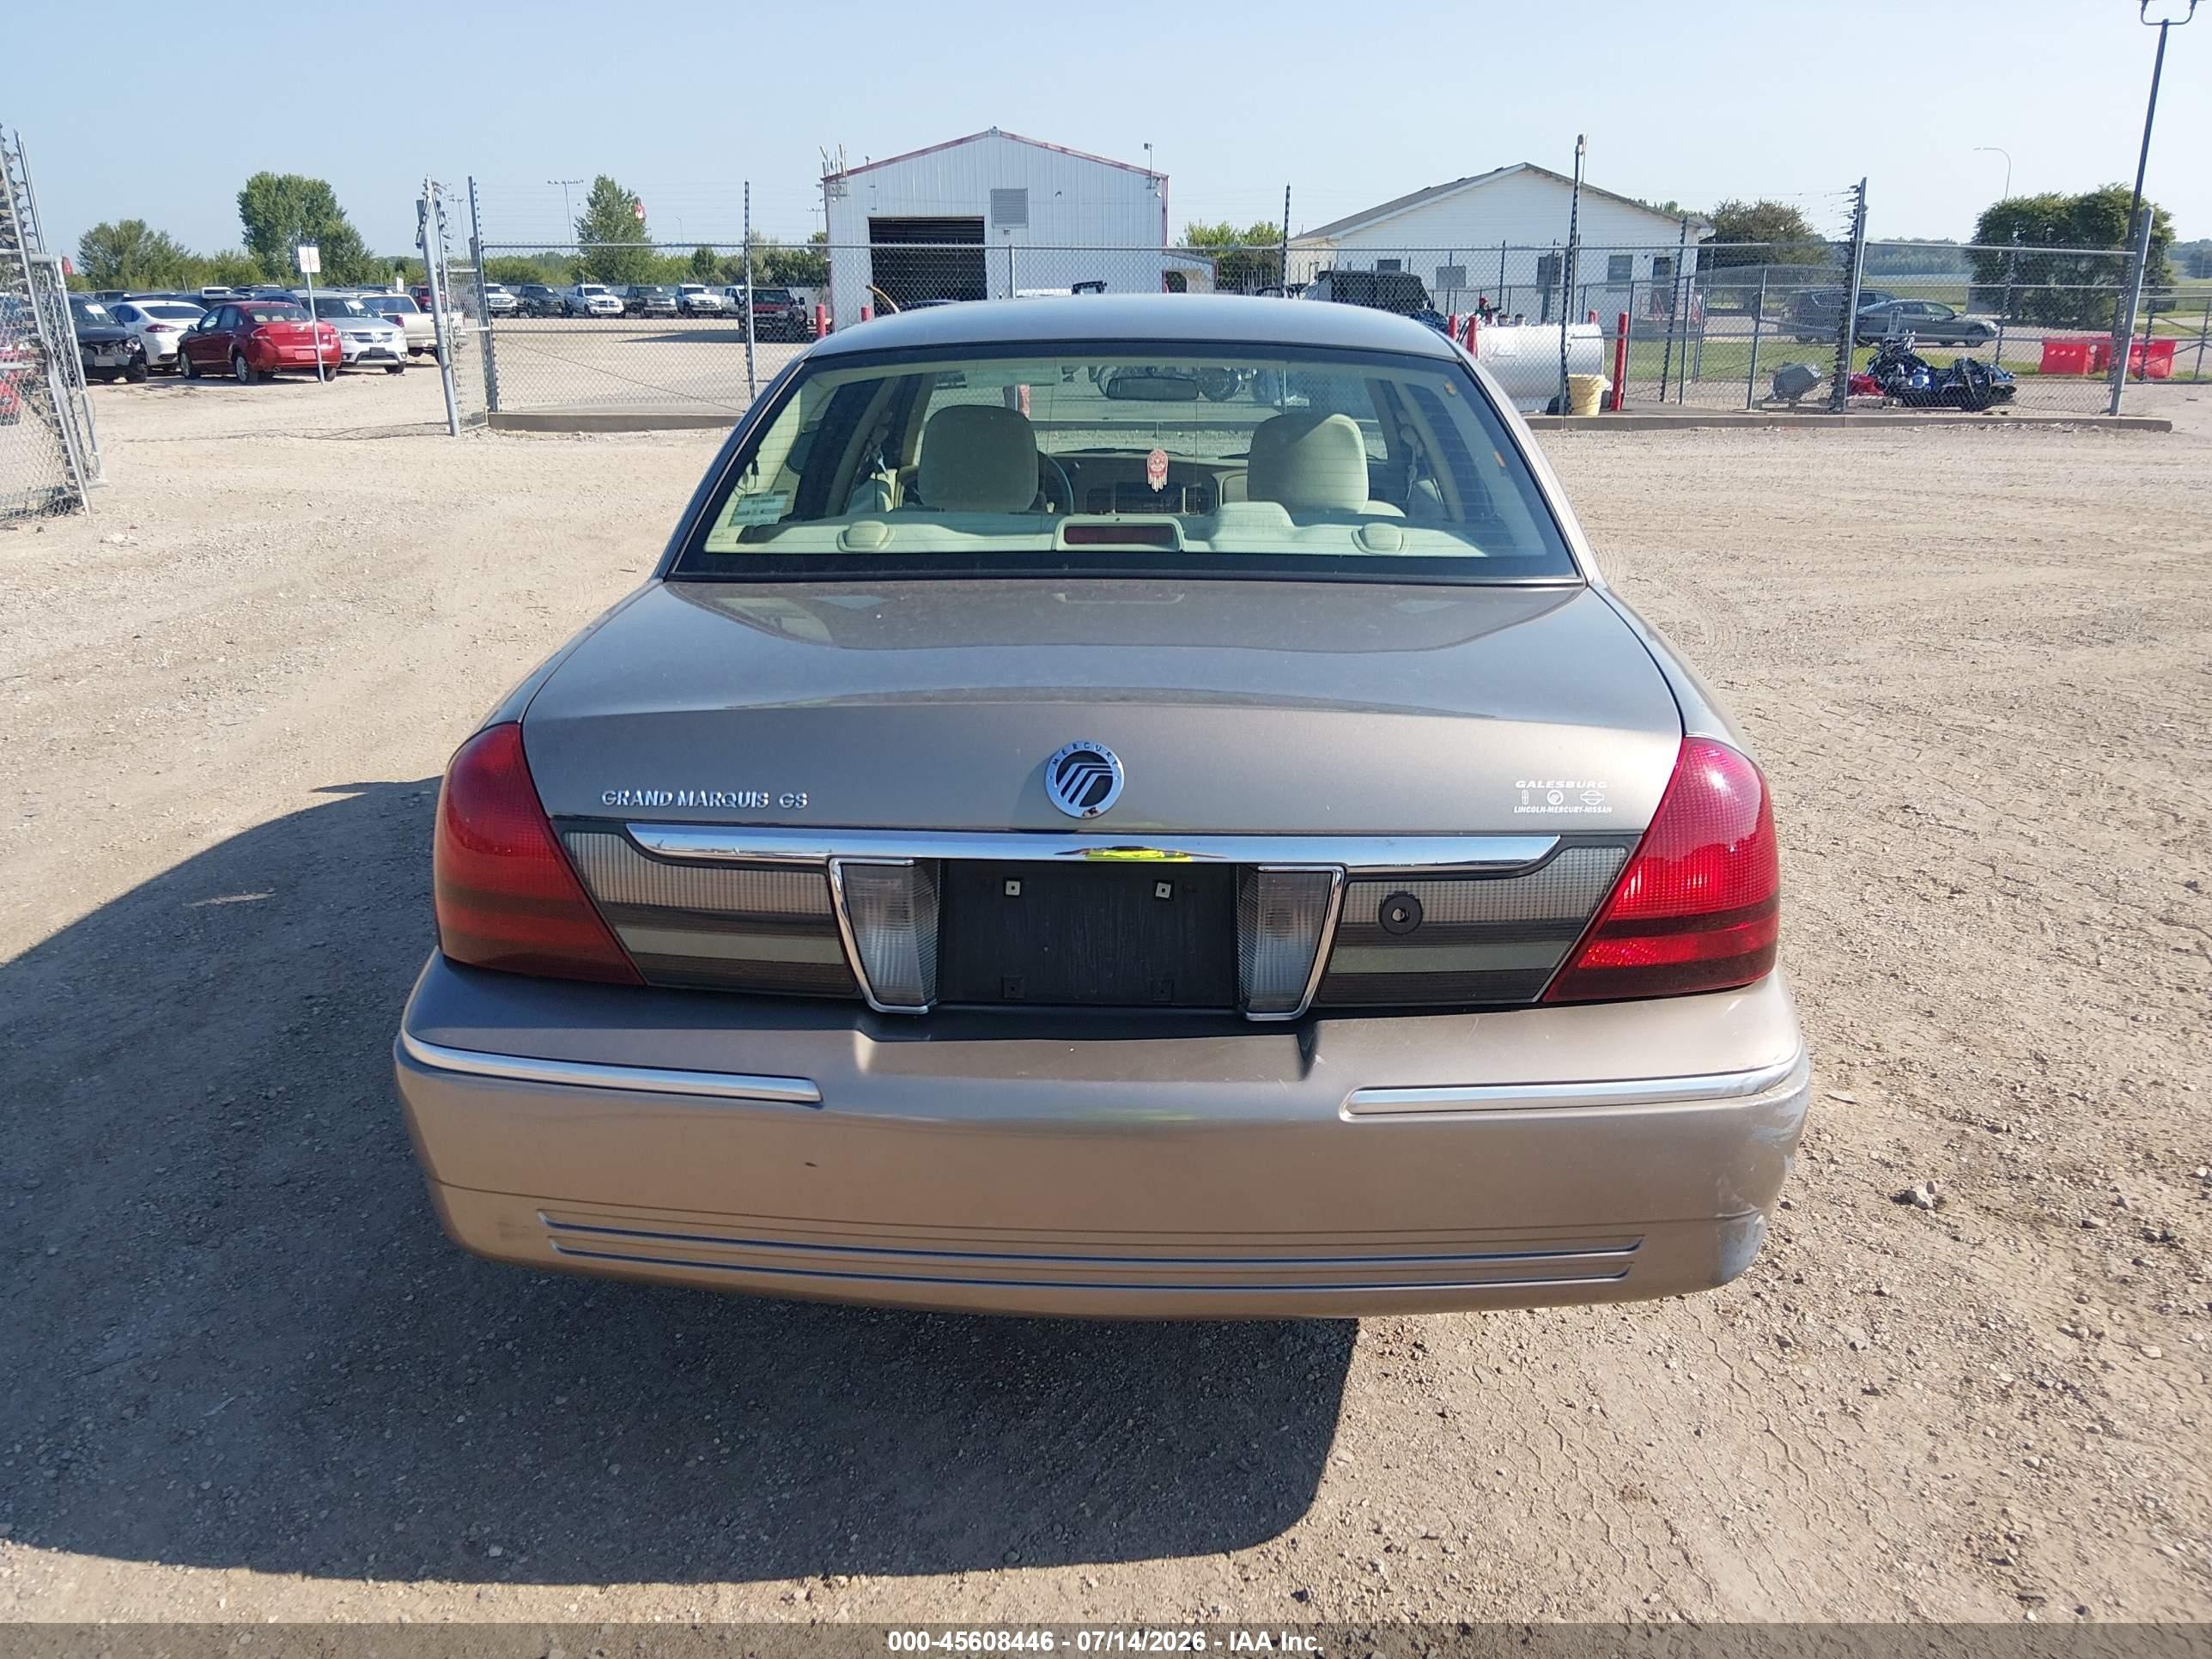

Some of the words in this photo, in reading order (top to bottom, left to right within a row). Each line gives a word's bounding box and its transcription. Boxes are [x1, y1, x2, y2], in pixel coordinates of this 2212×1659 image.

[1052, 742, 1119, 767] MERCURY
[1515, 780, 1608, 789] GALESBURG
[602, 789, 673, 807] GRAND
[677, 790, 769, 809] MARQUIS
[779, 792, 809, 809] GS
